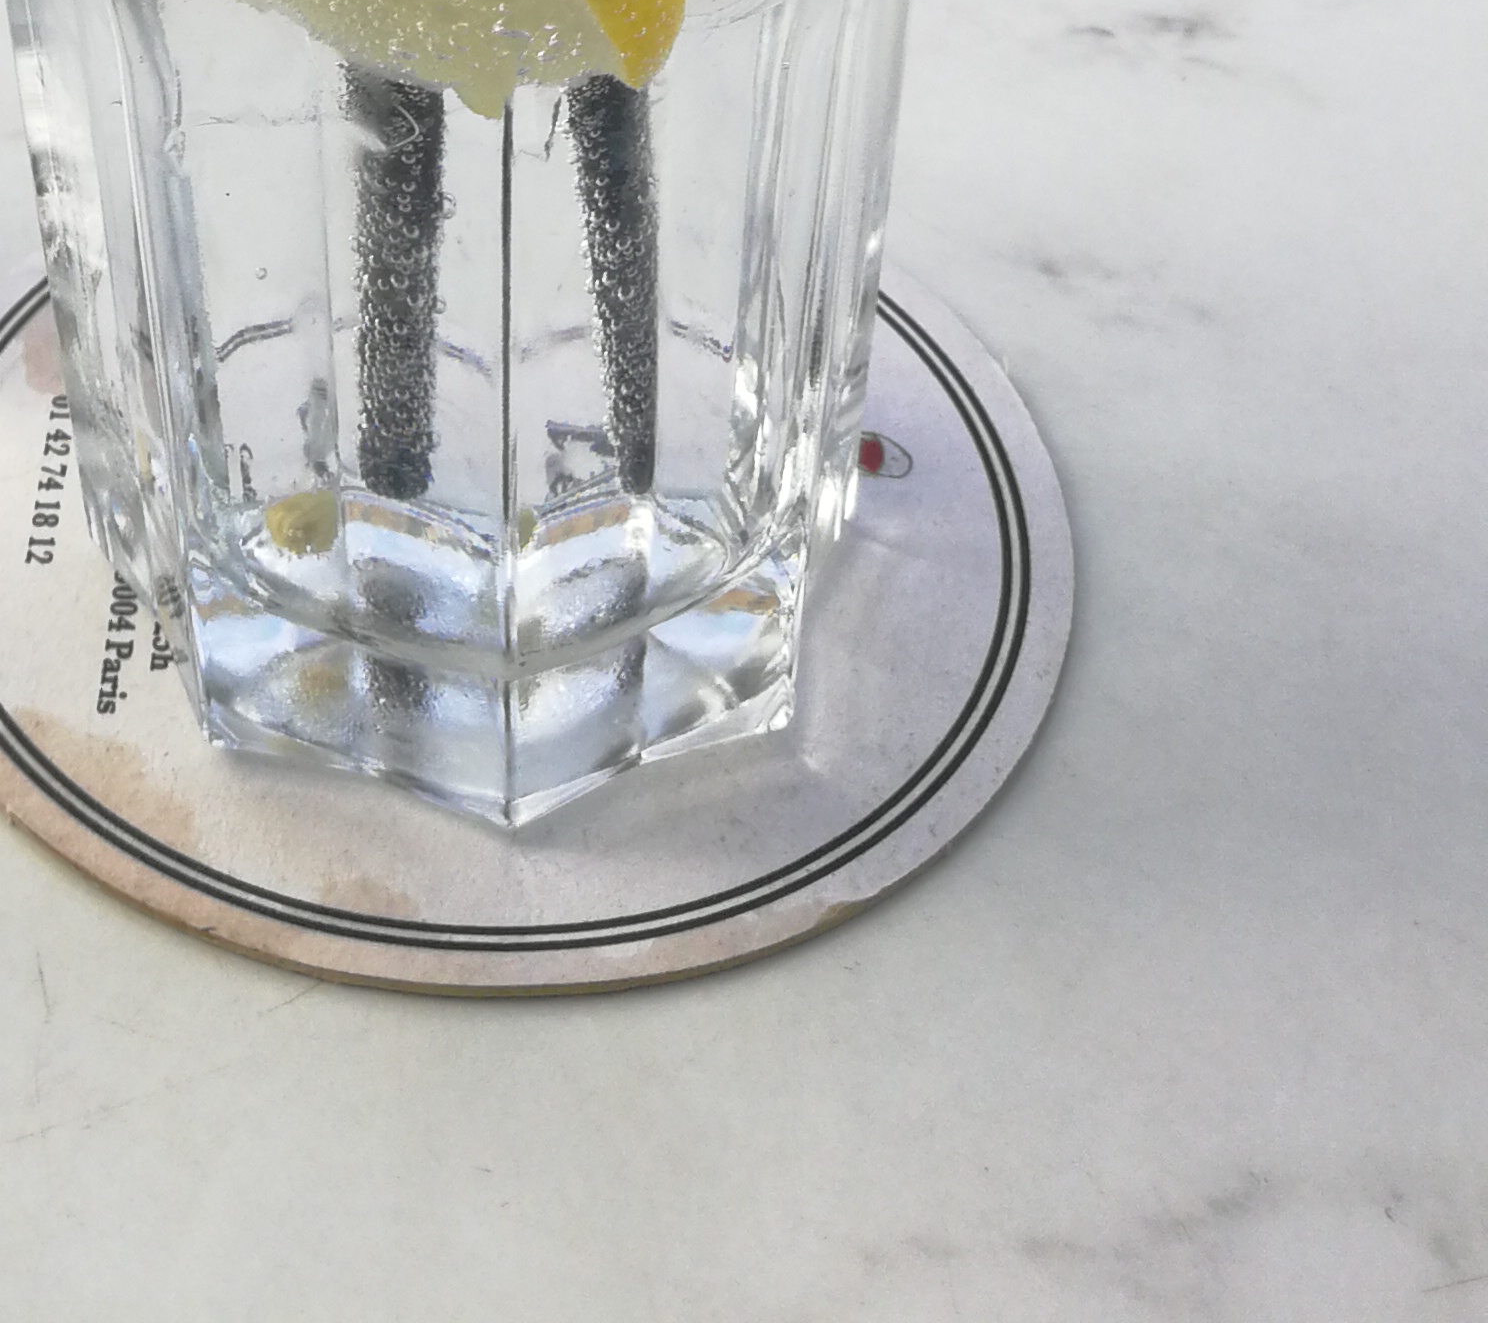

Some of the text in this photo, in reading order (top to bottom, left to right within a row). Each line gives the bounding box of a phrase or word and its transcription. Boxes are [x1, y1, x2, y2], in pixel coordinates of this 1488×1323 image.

[43, 427, 72, 457] 42
[38, 463, 68, 493] 74
[31, 500, 62, 528] 18
[24, 536, 56, 566] 12
[96, 640, 135, 716] Paris
